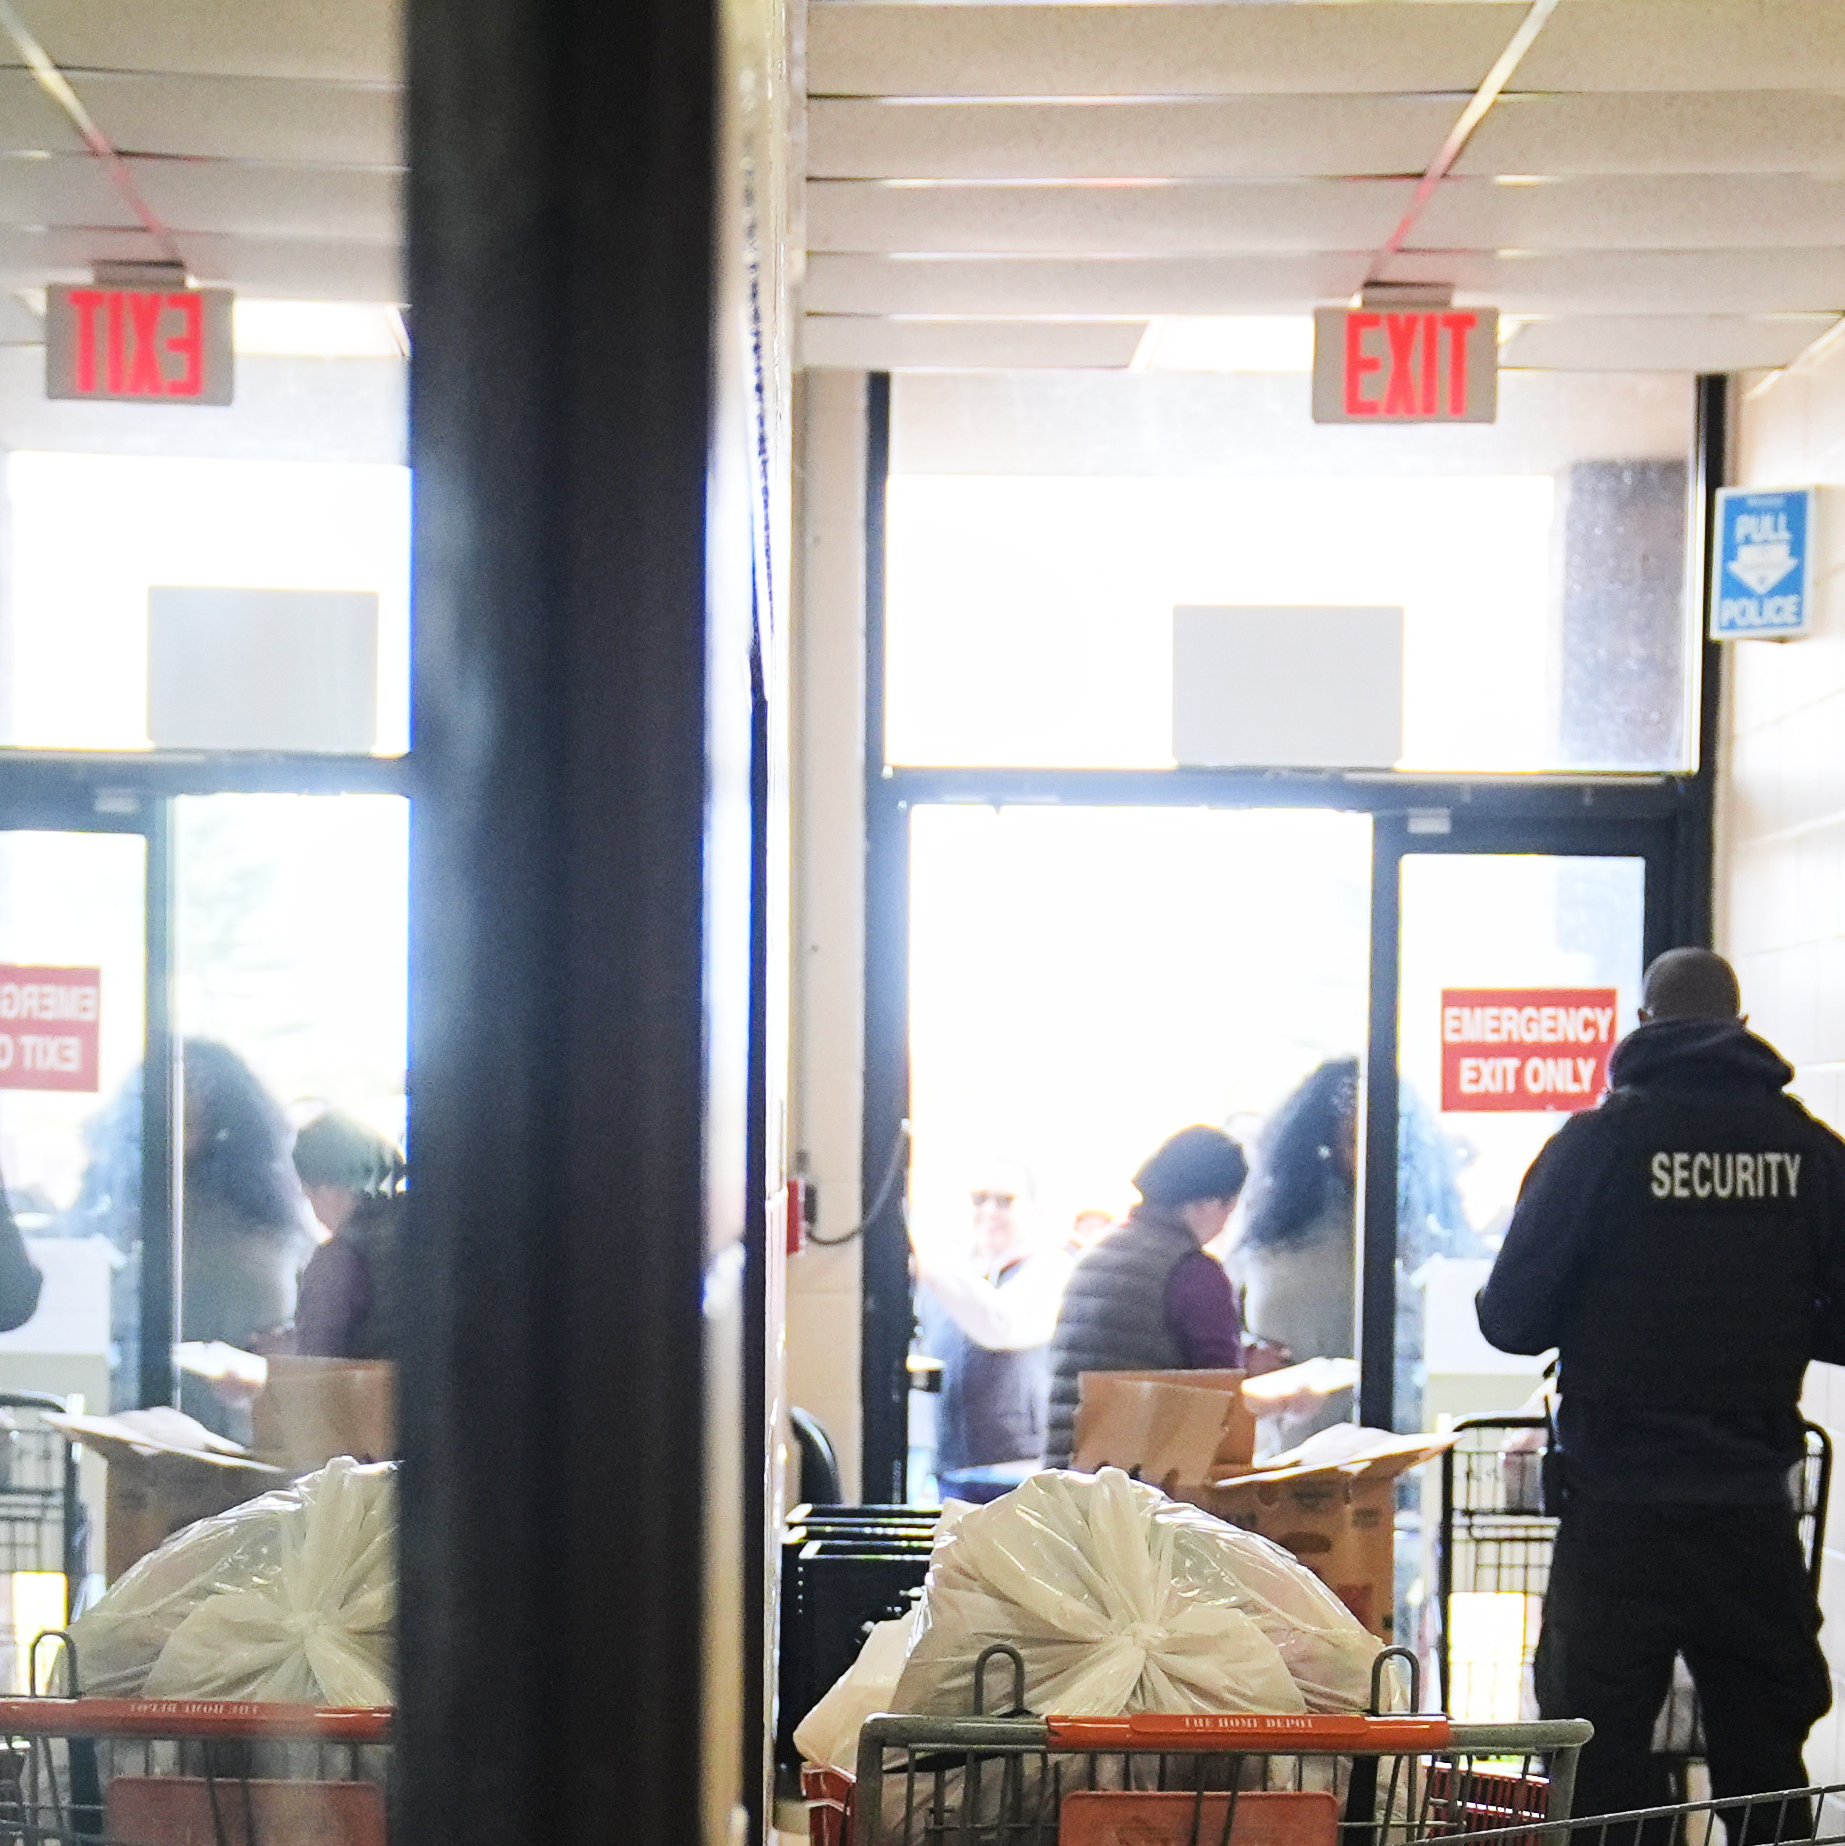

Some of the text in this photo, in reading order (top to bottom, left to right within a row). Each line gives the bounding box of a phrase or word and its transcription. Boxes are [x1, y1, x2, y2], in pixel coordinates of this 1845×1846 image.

[1345, 313, 1476, 417] EXIT
[1736, 512, 1791, 543] PULL
[1721, 594, 1799, 627] POLICE
[1444, 1007, 1614, 1043] EMERGENCY
[1460, 1057, 1596, 1094] EXIT ONLY
[1652, 1152, 1802, 1198] SECURITY
[1218, 1717, 1259, 1728] HOME
[1266, 1717, 1313, 1728] DEPOT
